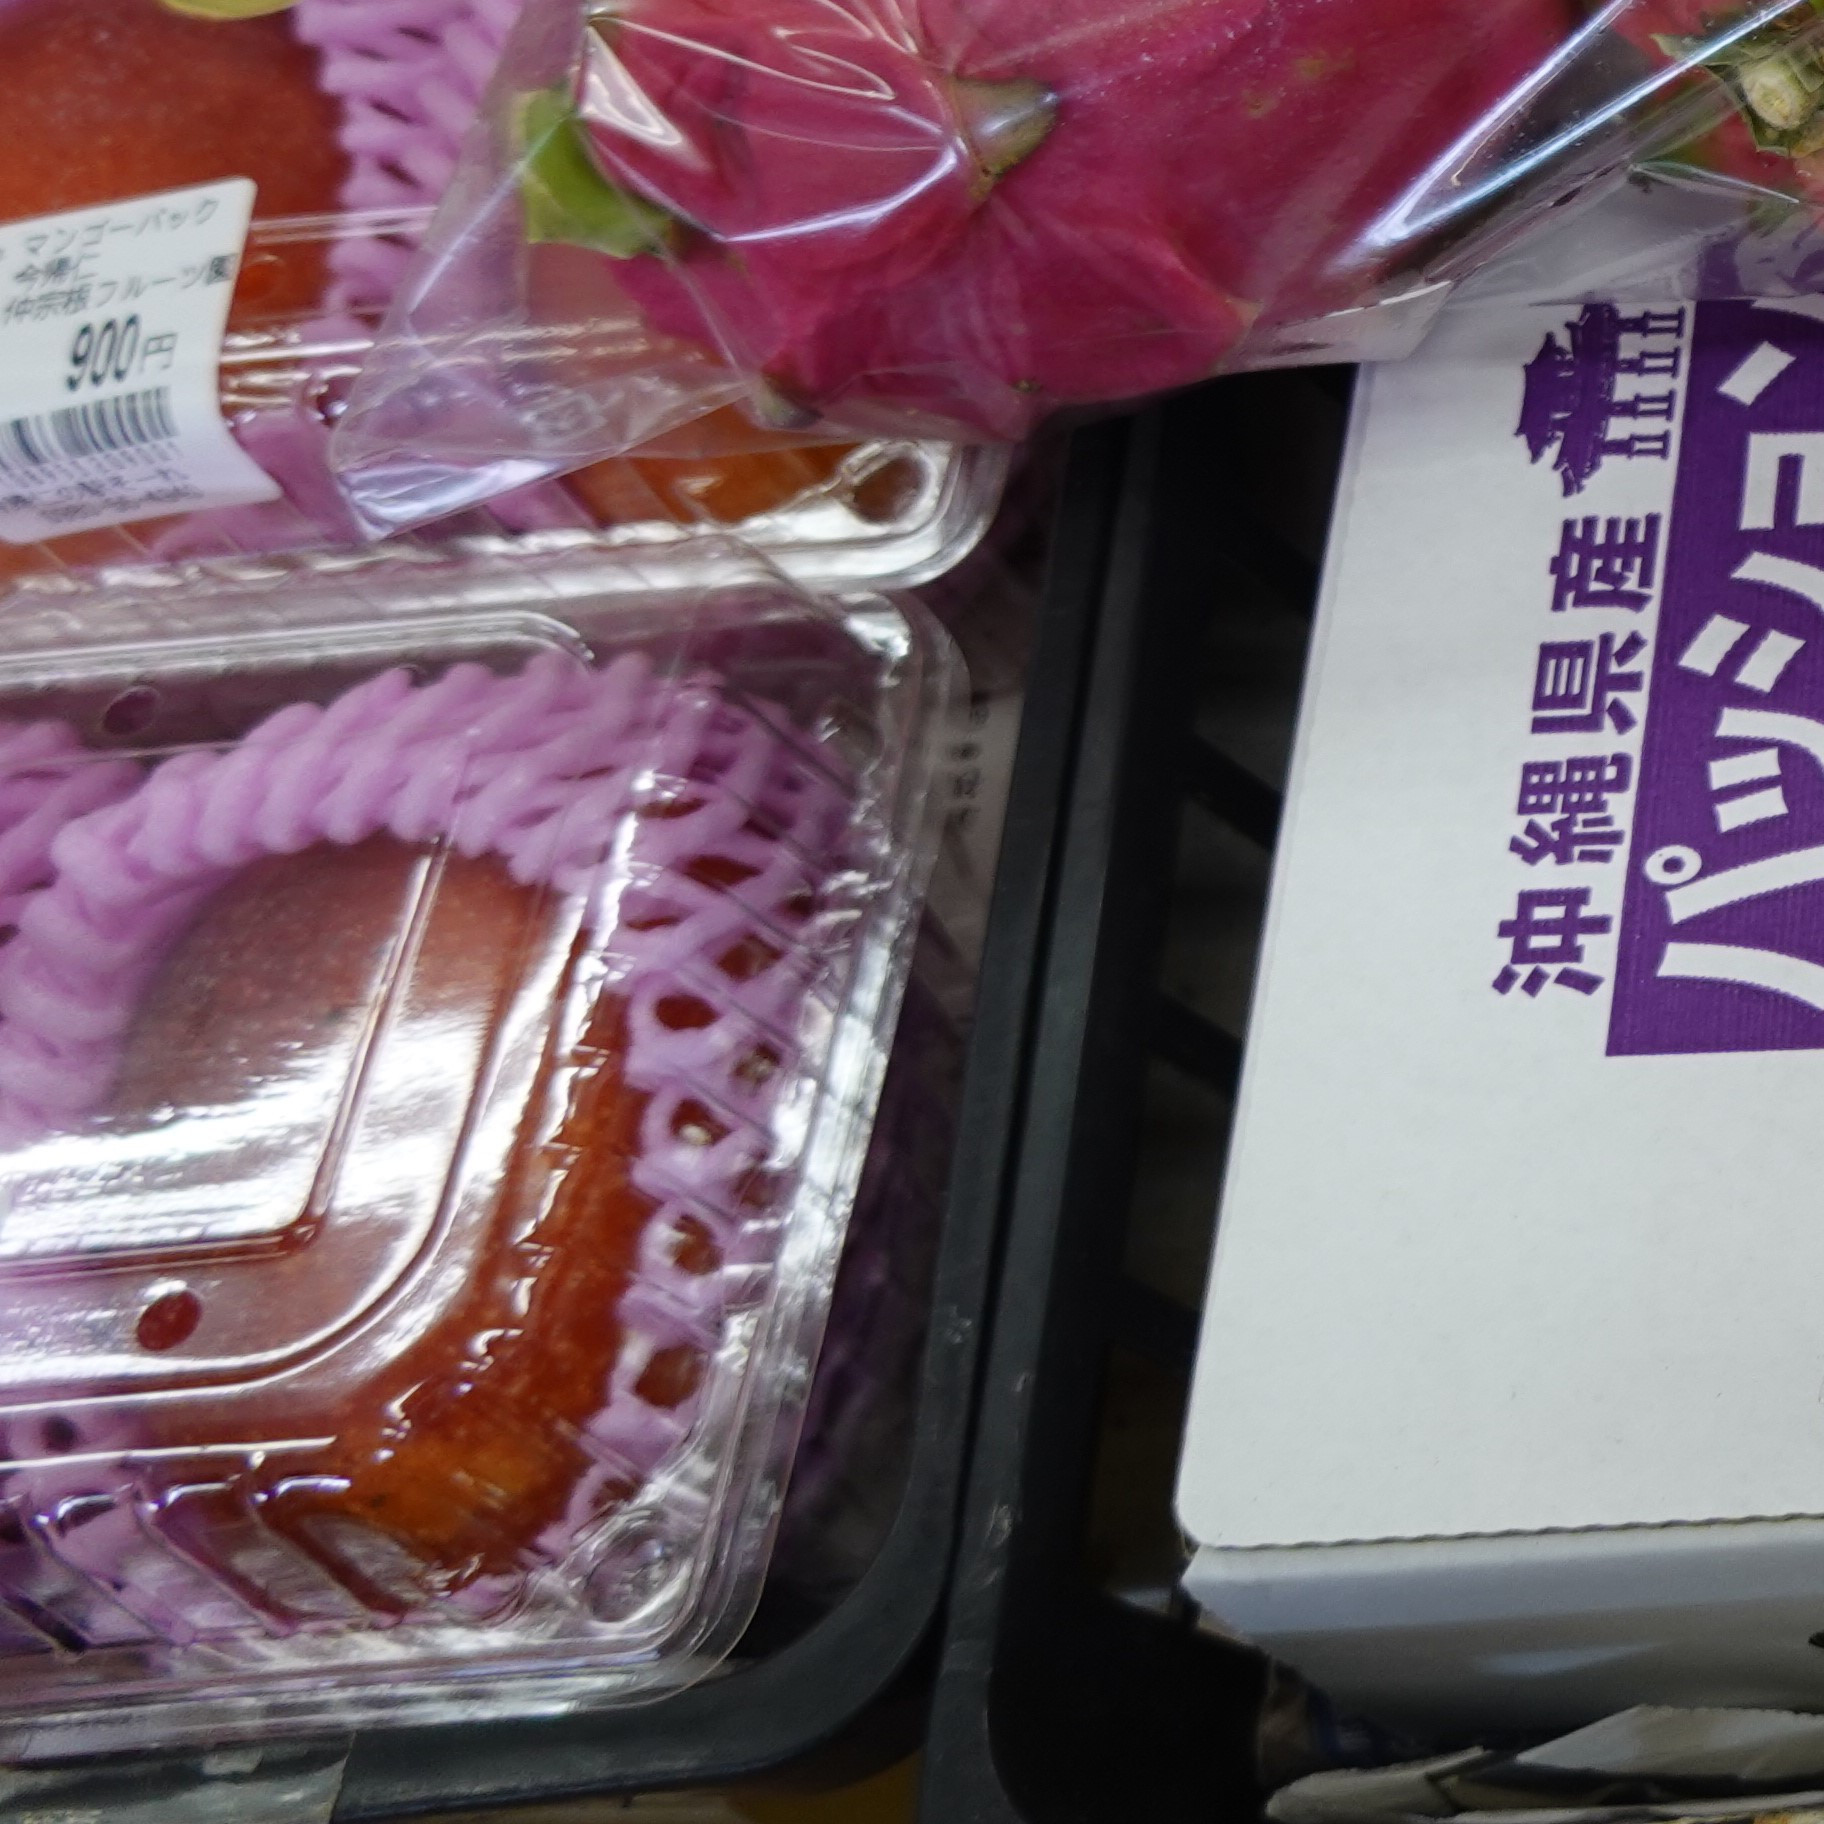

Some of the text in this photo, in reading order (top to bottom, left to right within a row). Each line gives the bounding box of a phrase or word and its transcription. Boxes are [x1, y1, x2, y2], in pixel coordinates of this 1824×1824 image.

[66, 312, 179, 393] 900円
[1490, 510, 1663, 1000] 沖縄県産
